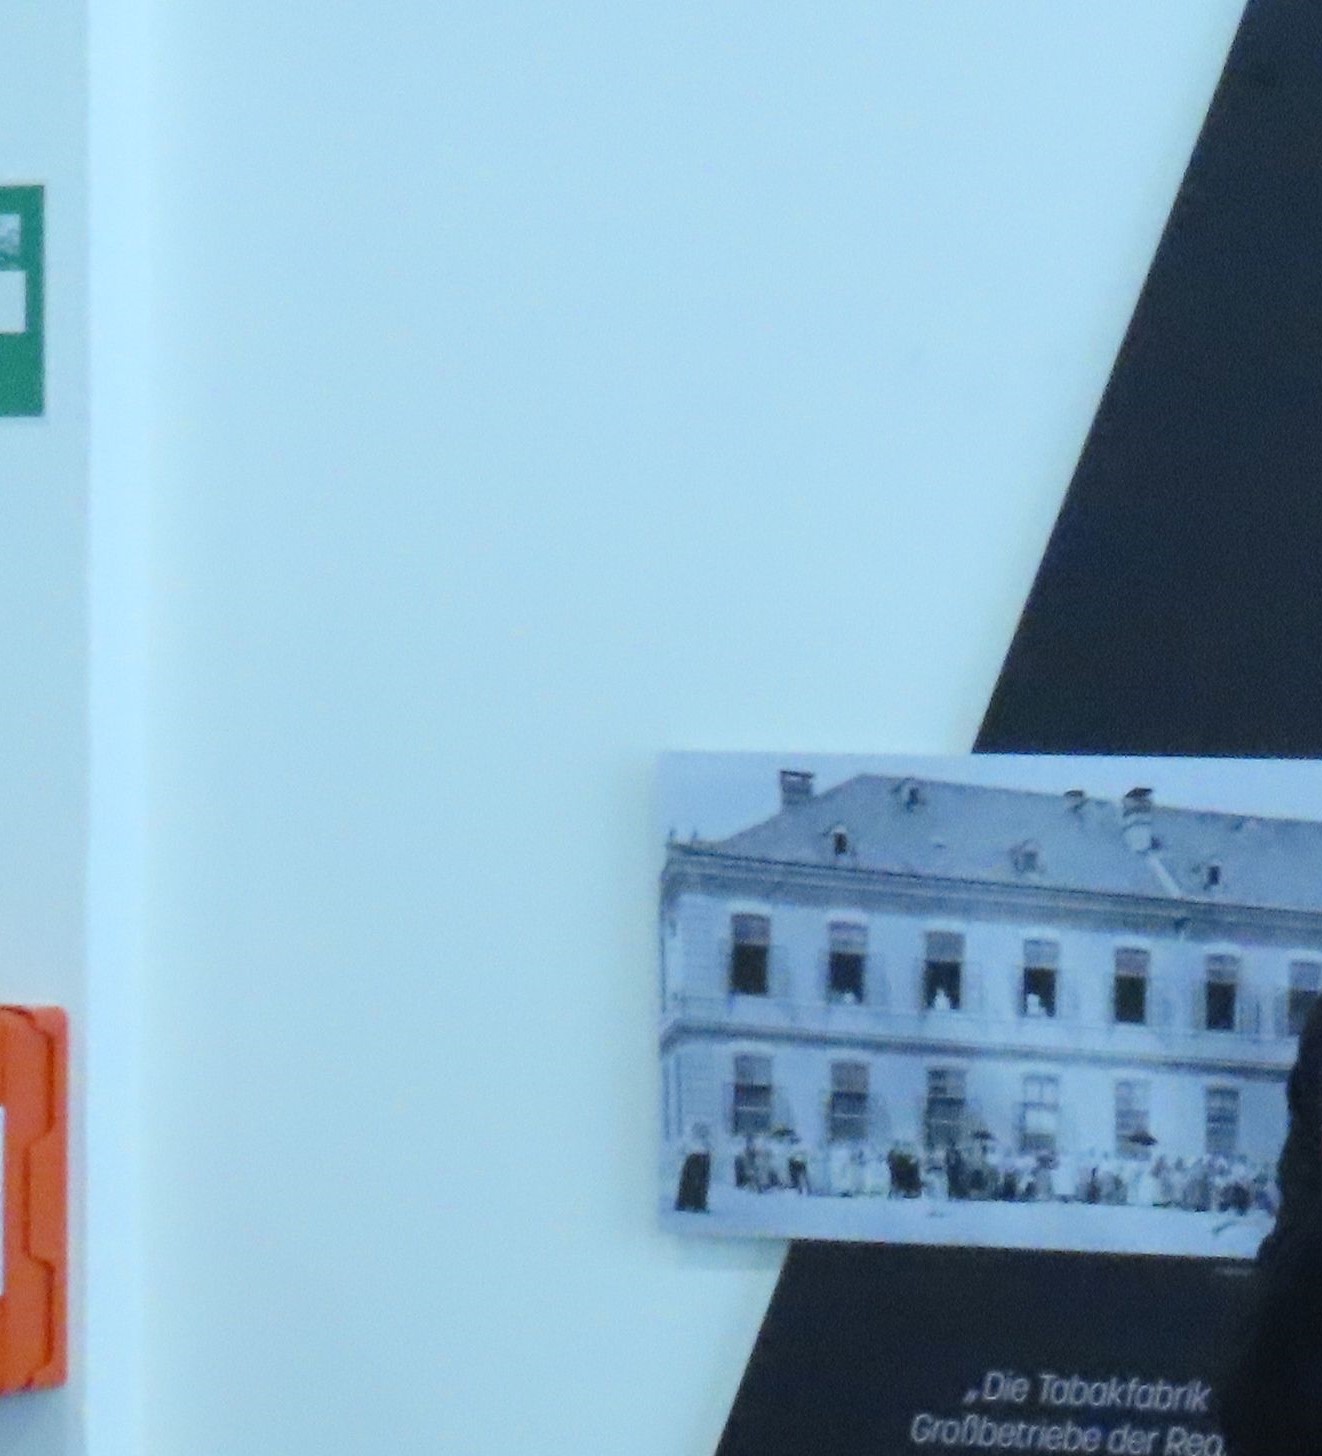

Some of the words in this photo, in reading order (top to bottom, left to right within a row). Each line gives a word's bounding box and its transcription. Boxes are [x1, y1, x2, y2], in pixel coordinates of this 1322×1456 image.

[1039, 1372, 1212, 1413] Tabakfabrik
[910, 1412, 1099, 1453] Großbetriebe
[1108, 1423, 1156, 1456] der
